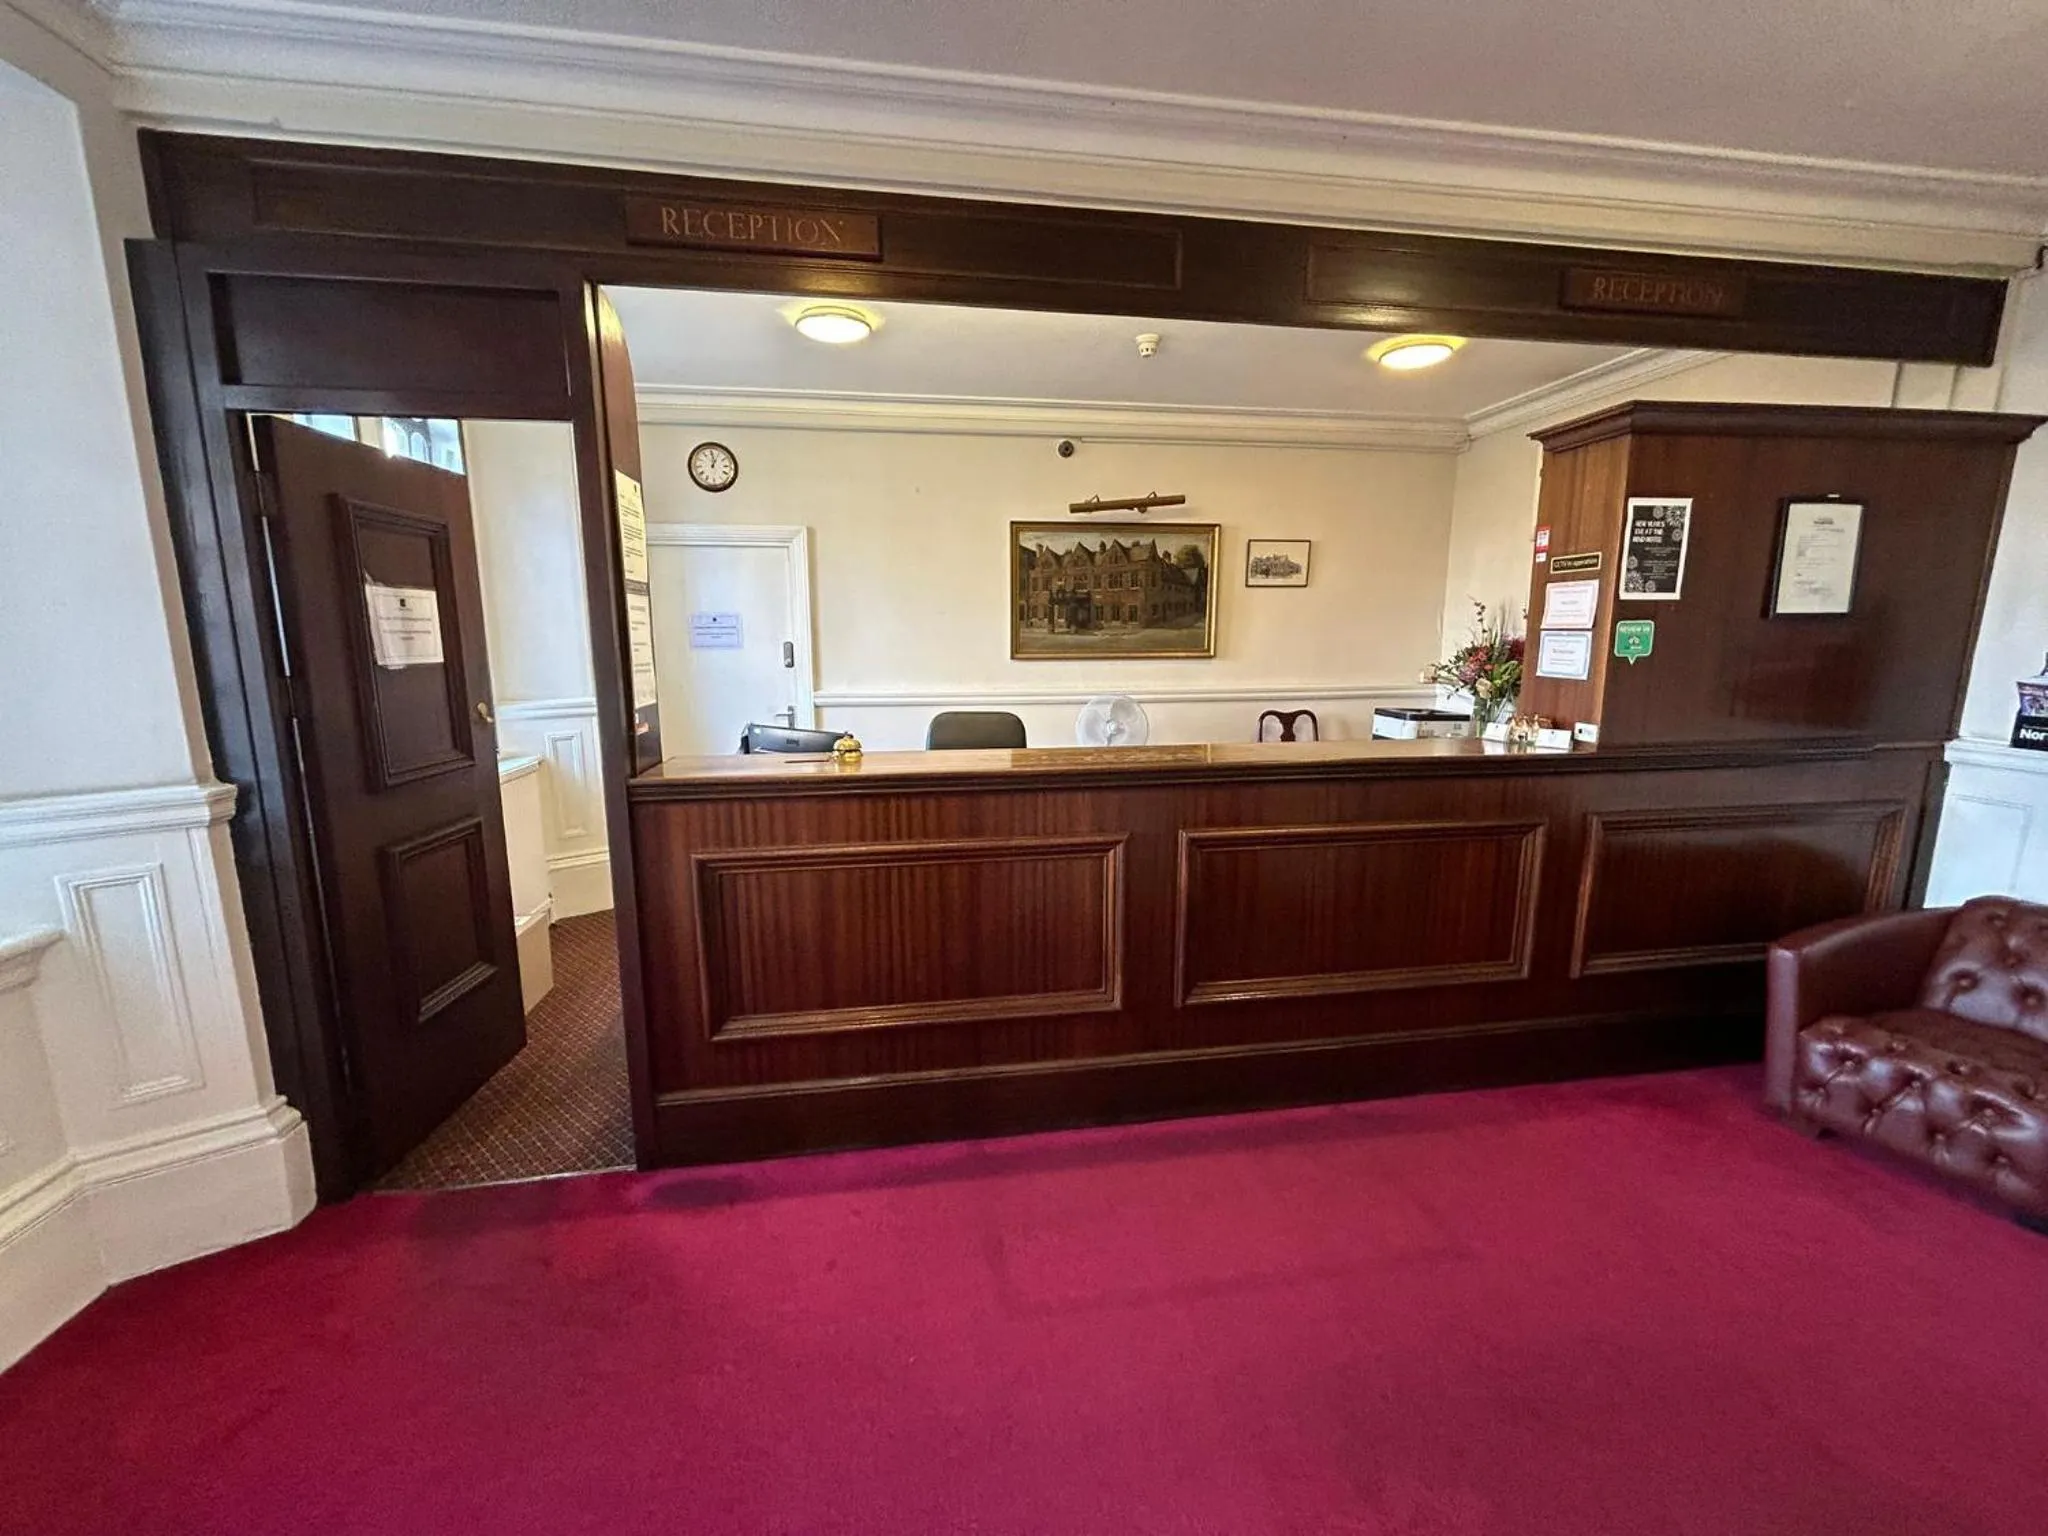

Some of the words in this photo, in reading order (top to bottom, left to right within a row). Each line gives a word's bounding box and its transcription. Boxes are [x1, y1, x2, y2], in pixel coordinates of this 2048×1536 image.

[661, 206, 842, 245] RECEPTION
[1593, 276, 1724, 309] RECEPTION
[2019, 728, 2048, 740] Nor
